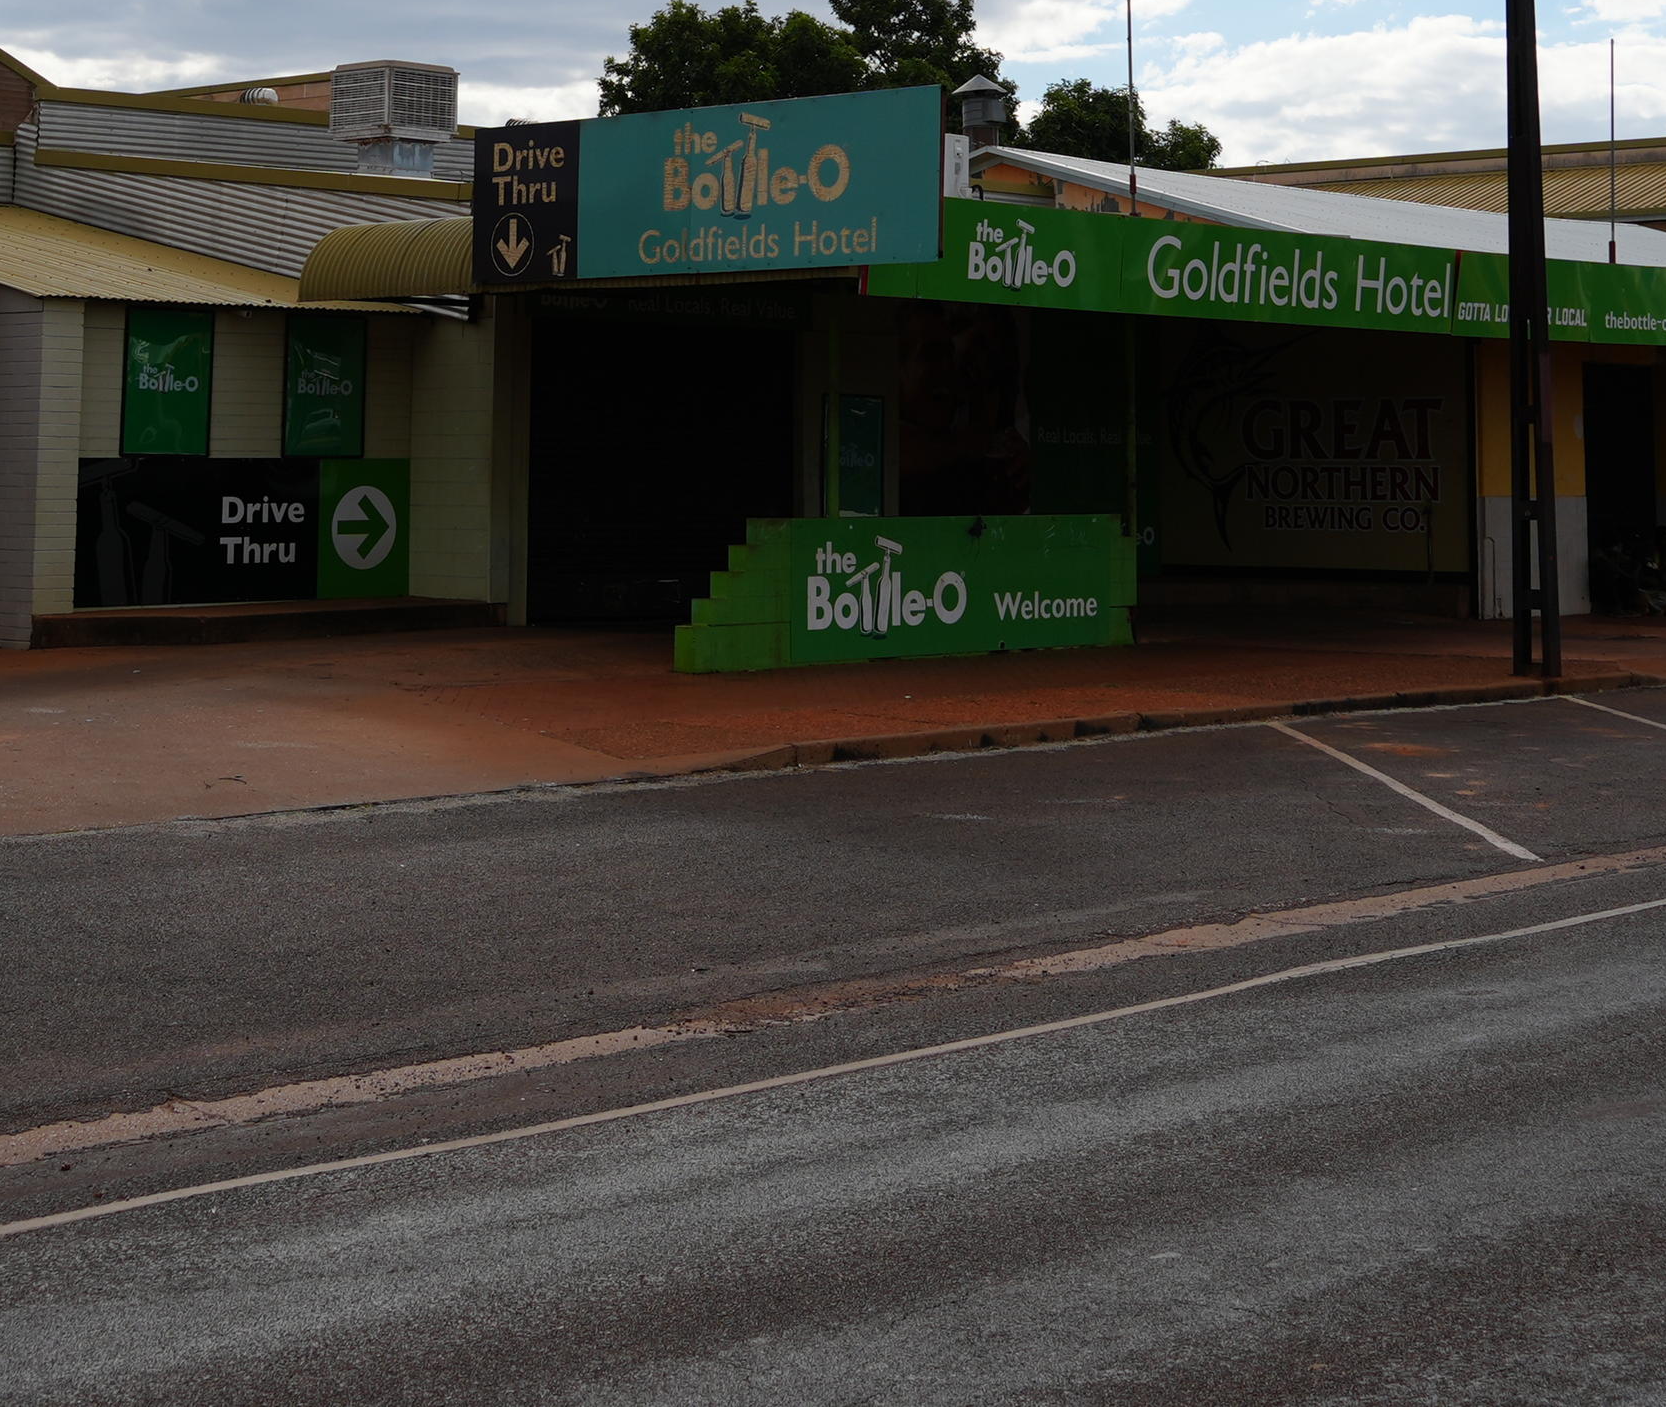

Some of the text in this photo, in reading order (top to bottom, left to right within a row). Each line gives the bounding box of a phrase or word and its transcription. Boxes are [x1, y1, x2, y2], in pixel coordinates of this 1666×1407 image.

[674, 122, 718, 156] the
[492, 140, 565, 172] Drive
[492, 176, 556, 206] Thru
[638, 216, 878, 265] Goldfields Hotel
[976, 219, 1004, 243] the
[1147, 235, 1451, 319] Goldfields Hotel
[1458, 302, 1491, 322] GOTTA
[1555, 307, 1588, 327] LOCAL
[143, 363, 158, 374] the
[1037, 426, 1060, 442] Real
[1241, 397, 1445, 462] GREAT
[1245, 465, 1440, 502] NORTHERN
[222, 496, 305, 524] Drive
[1264, 505, 1426, 531] BREWING CO.
[219, 537, 296, 564] Thru
[816, 542, 857, 574] the
[993, 591, 1098, 620] Welcome
